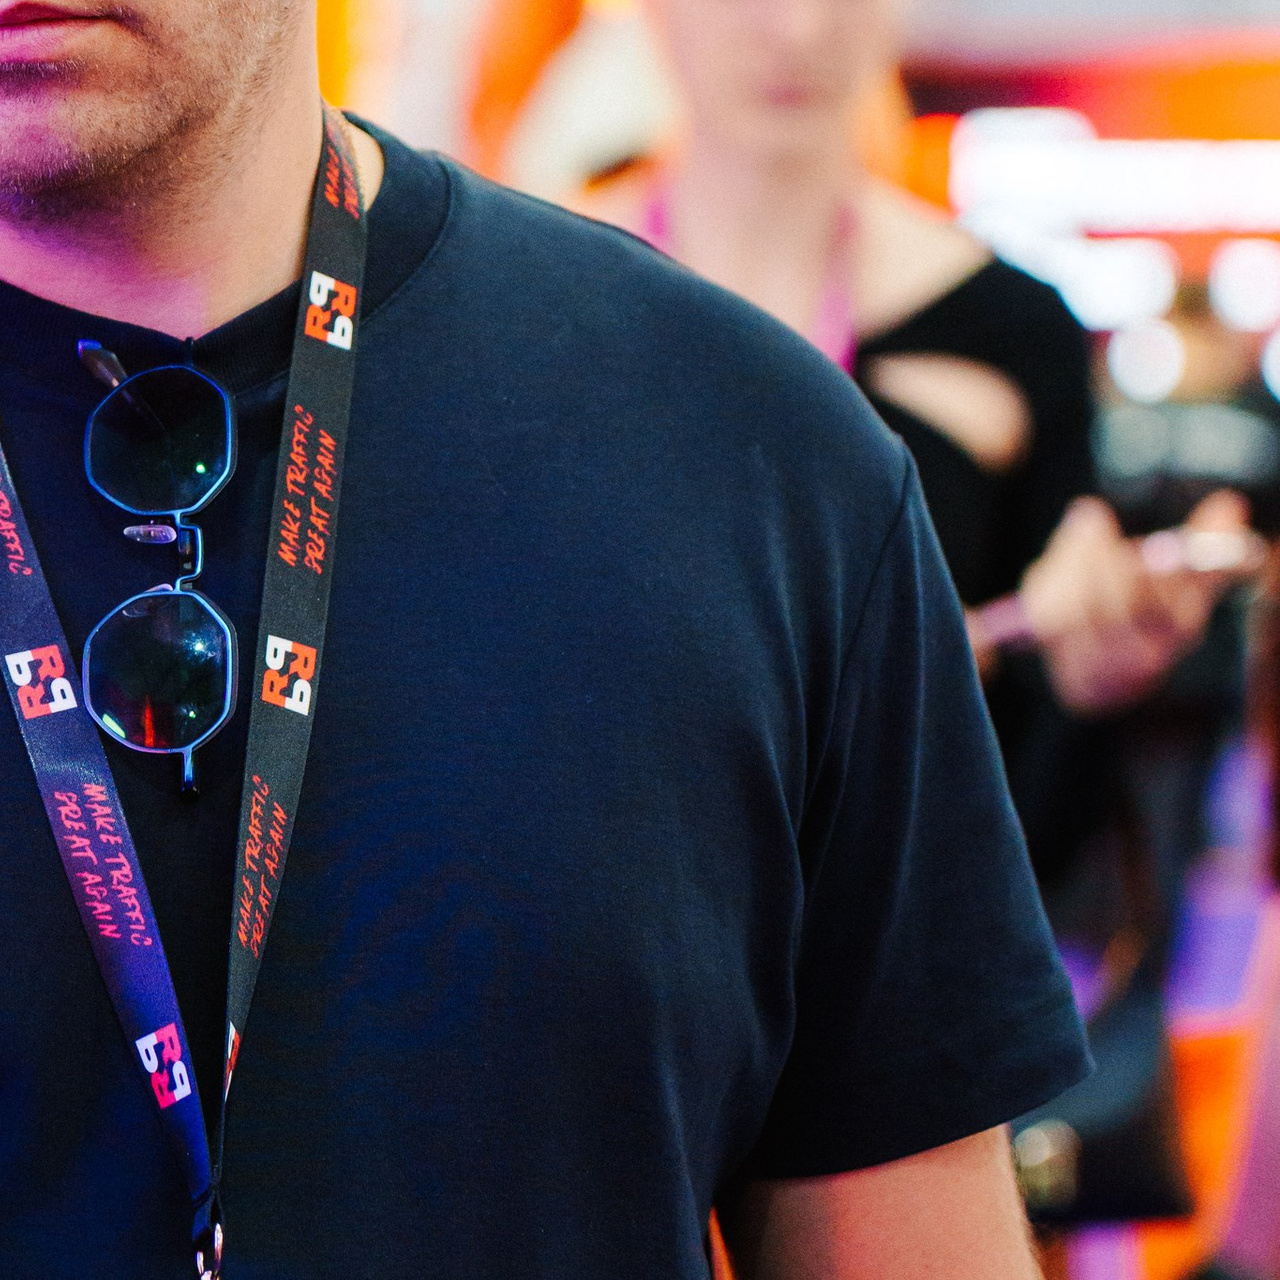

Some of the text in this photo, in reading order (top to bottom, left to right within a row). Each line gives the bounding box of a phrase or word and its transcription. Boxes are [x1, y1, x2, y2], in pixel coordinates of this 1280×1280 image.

[277, 404, 314, 567] MAKE TRAFFIC
[304, 429, 337, 575] GREAT AGAIN
[54, 790, 121, 939] GREAT AGAIN
[81, 782, 153, 946] MAKE TRAFFIC
[238, 774, 270, 948] MAKE TRAFFIC
[249, 802, 289, 959] GREAT AGAIN
